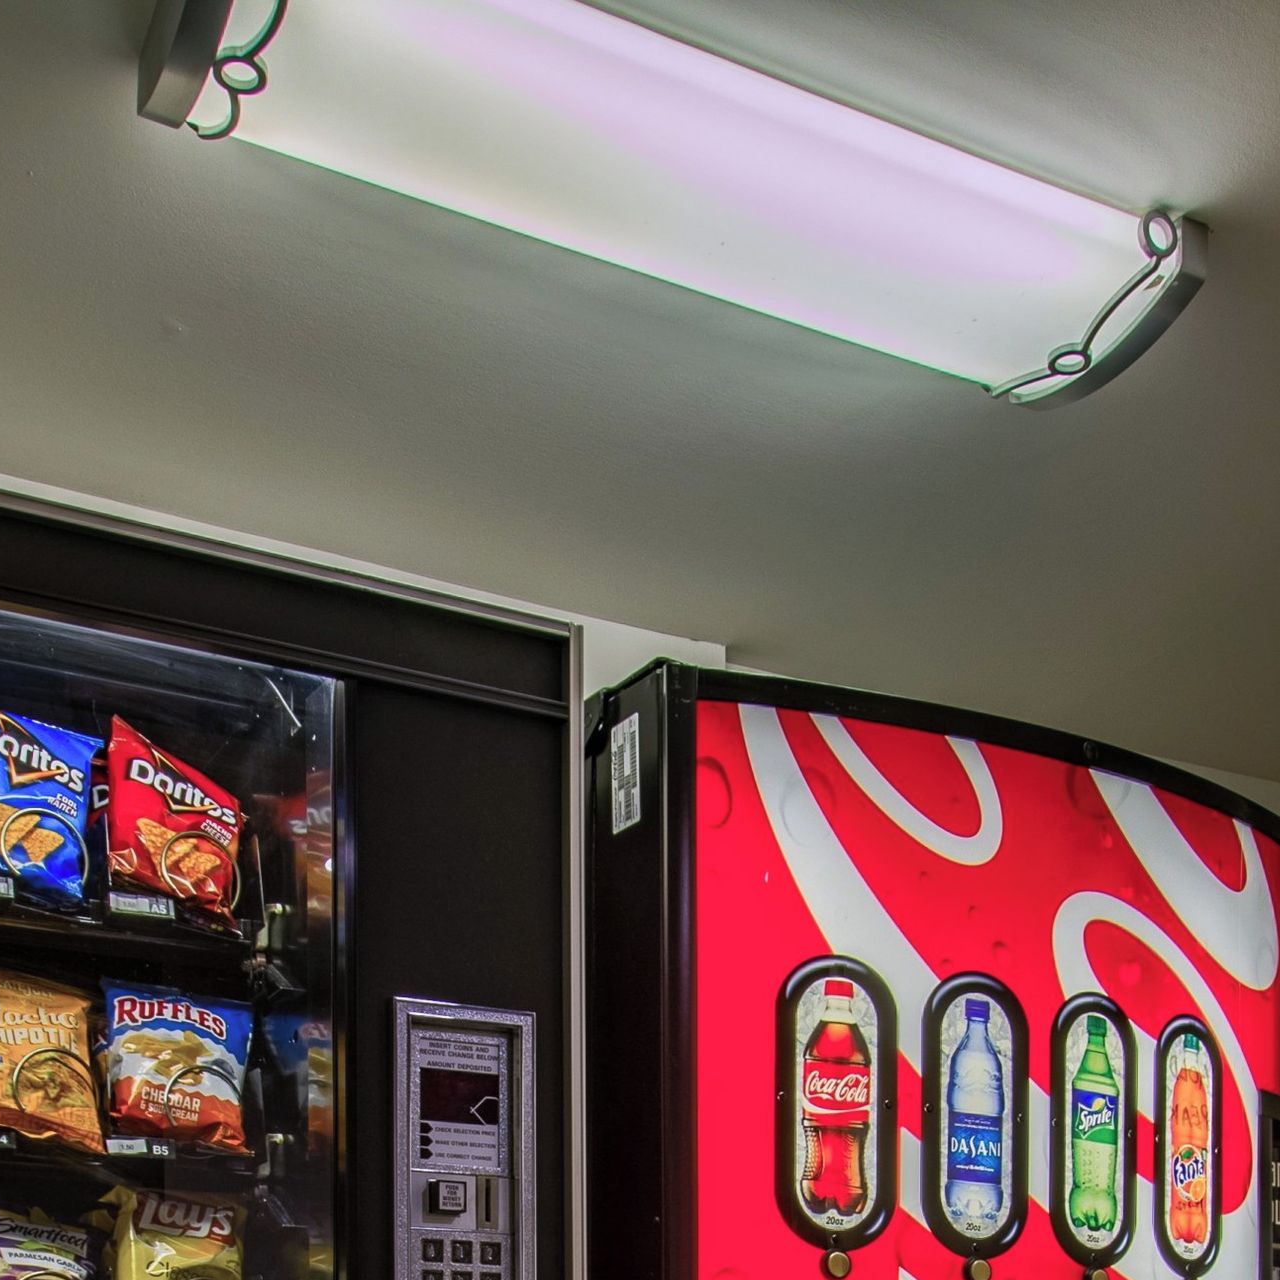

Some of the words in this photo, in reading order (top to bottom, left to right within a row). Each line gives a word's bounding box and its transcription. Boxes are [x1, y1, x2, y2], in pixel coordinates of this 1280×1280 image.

[128, 758, 237, 825] Doritos
[47, 797, 78, 818] RANCH
[56, 793, 79, 809] COOL
[200, 822, 231, 848] CHEESE
[205, 818, 233, 841] NACHO
[151, 903, 168, 915] A5
[114, 996, 227, 1040] RUFFLES
[420, 1048, 446, 1057] RECEIVE
[447, 1051, 474, 1060] CHANGE
[476, 1054, 500, 1062] BELOW
[429, 1042, 451, 1050] INSERT
[454, 1044, 474, 1052] COINS
[426, 1060, 456, 1069] AMOUNT
[457, 1063, 493, 1072] DEPOSITED
[805, 1070, 869, 1104] Coca-Cola
[141, 1085, 201, 1113] CHEDDAR
[170, 1108, 199, 1122] CREAM
[1078, 1106, 1115, 1134] Sprite
[153, 1145, 169, 1156] B5
[950, 1134, 1002, 1158] DASANI
[138, 1190, 234, 1238] Lay's
[825, 1215, 845, 1227] 20oz
[965, 1221, 982, 1232] 20oz
[7, 1251, 56, 1264] PARMESAN
